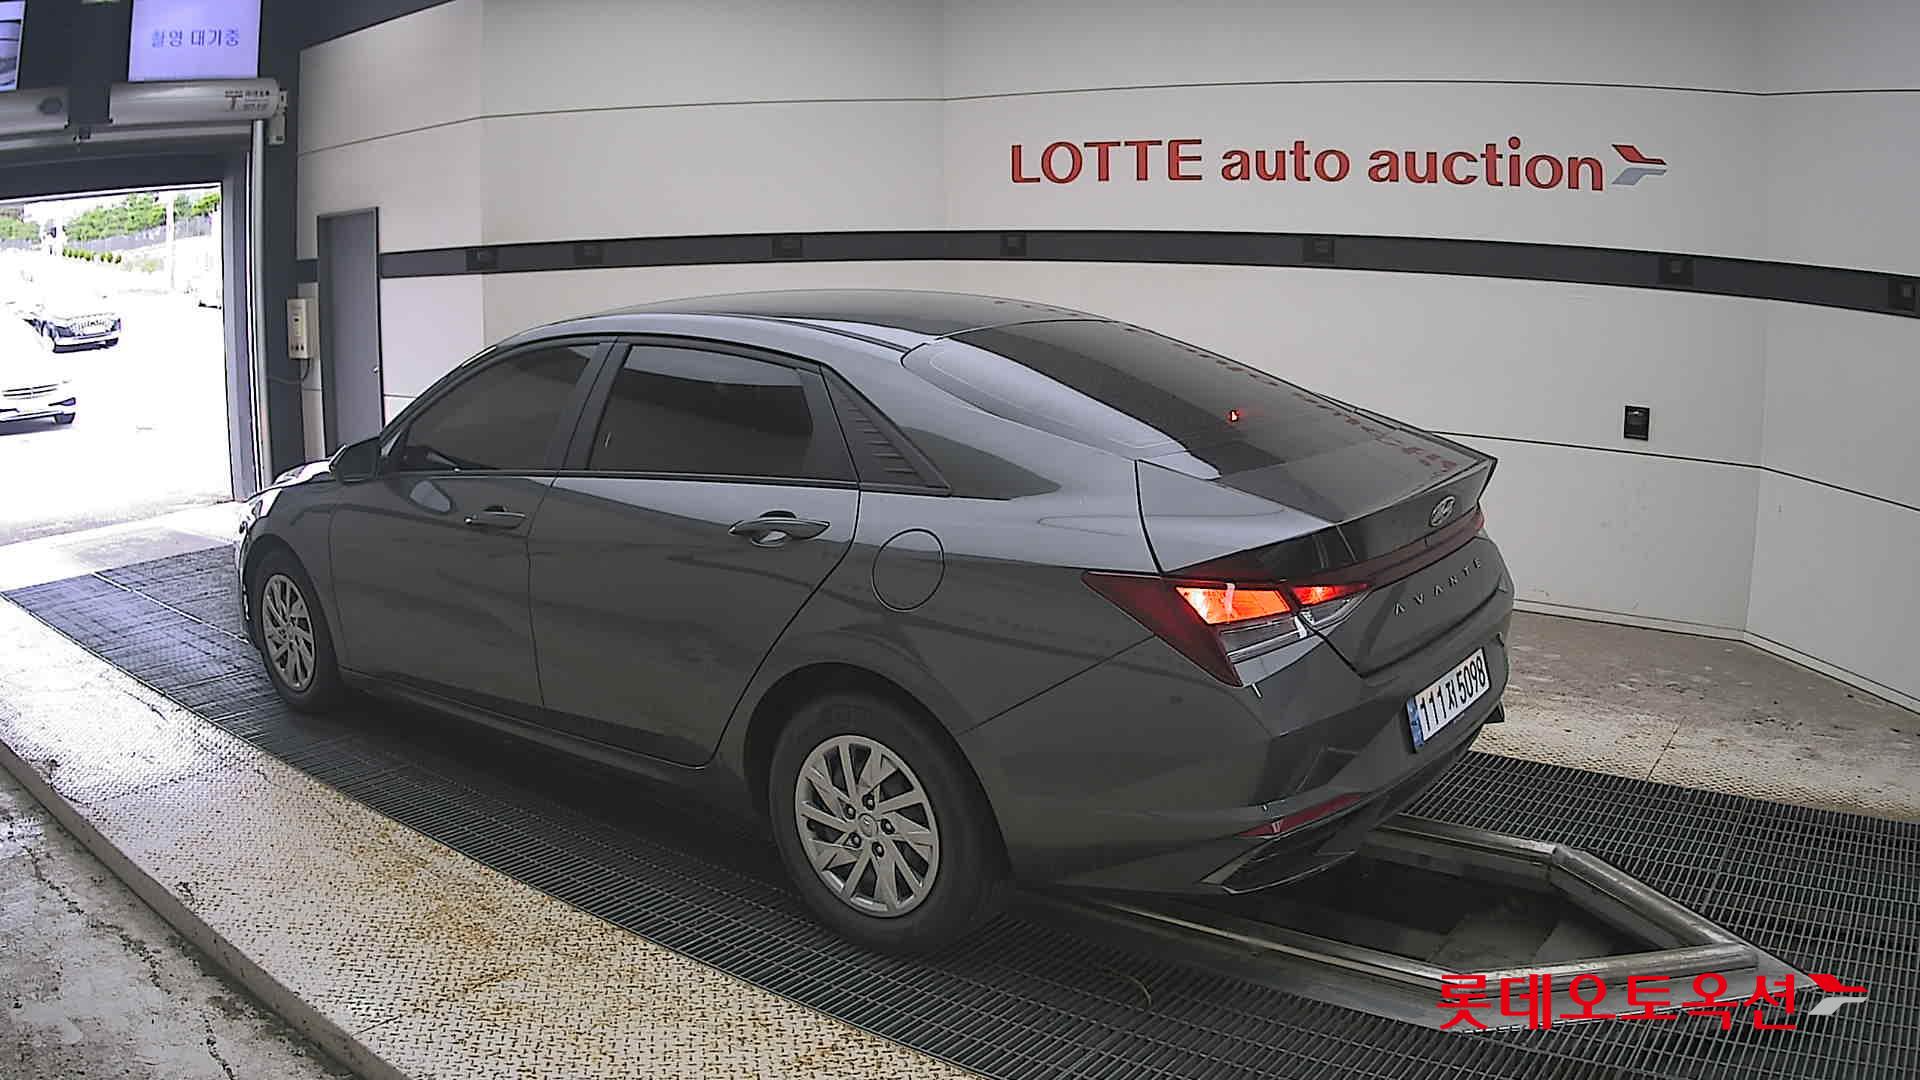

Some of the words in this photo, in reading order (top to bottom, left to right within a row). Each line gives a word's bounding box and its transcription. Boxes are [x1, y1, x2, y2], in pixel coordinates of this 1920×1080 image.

[191, 28, 239, 47] 대기중
[1010, 139, 1203, 184] LOTTE
[1220, 140, 1351, 183] auto
[1367, 136, 1604, 191] auction
[1394, 557, 1482, 617] AVANTE
